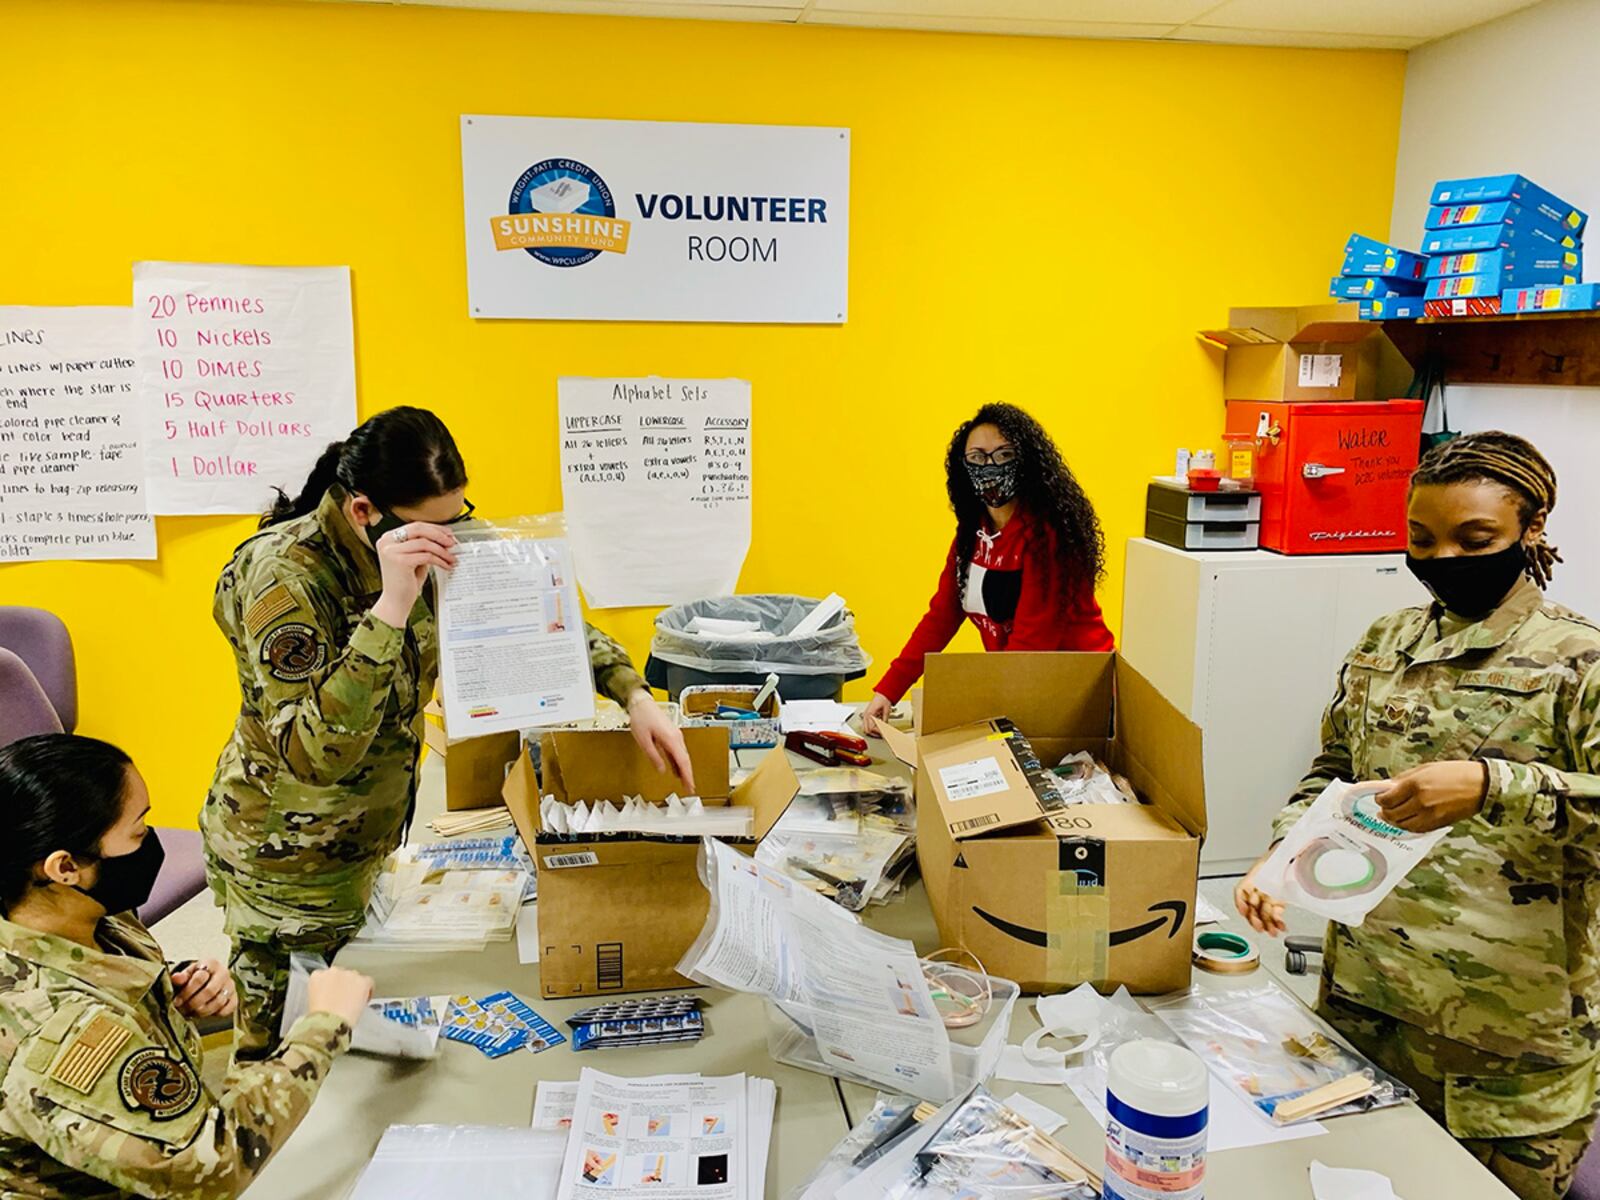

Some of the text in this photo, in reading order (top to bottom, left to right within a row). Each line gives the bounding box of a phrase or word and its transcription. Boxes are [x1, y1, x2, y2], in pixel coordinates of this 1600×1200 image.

[512, 160, 612, 206] WRIGHT-PATT CREDIT UNION
[635, 193, 828, 224] VOLUNTEER
[500, 217, 624, 239] SUNSHINE
[511, 235, 615, 248] COMMUNITY FUND
[688, 236, 777, 262] ROOM
[149, 294, 265, 319] 20 Pennies
[157, 328, 272, 347] 10 Nickels
[162, 359, 183, 379] 10
[19, 387, 55, 397] where
[64, 384, 83, 395] the
[90, 383, 116, 395] star
[120, 383, 131, 393] is
[613, 384, 708, 404] Alphabet Sets
[6, 398, 28, 409] end
[164, 392, 184, 408] 15
[44, 417, 65, 429] pipe
[69, 415, 108, 426] cleaner
[164, 421, 177, 439] 5
[188, 420, 228, 438] Half
[565, 415, 623, 430] UPPERCASE
[705, 416, 750, 428] ACCESSORY
[23, 431, 52, 442] color
[62, 429, 91, 441] bead
[100, 449, 123, 461] tape
[13, 465, 36, 475] pipe
[41, 463, 80, 474] cleaner
[34, 483, 45, 494] to
[16, 512, 53, 523] staple
[23, 533, 70, 546] complete
[75, 534, 94, 545] put
[98, 534, 109, 543] in
[1487, 671, 1505, 686] AIR
